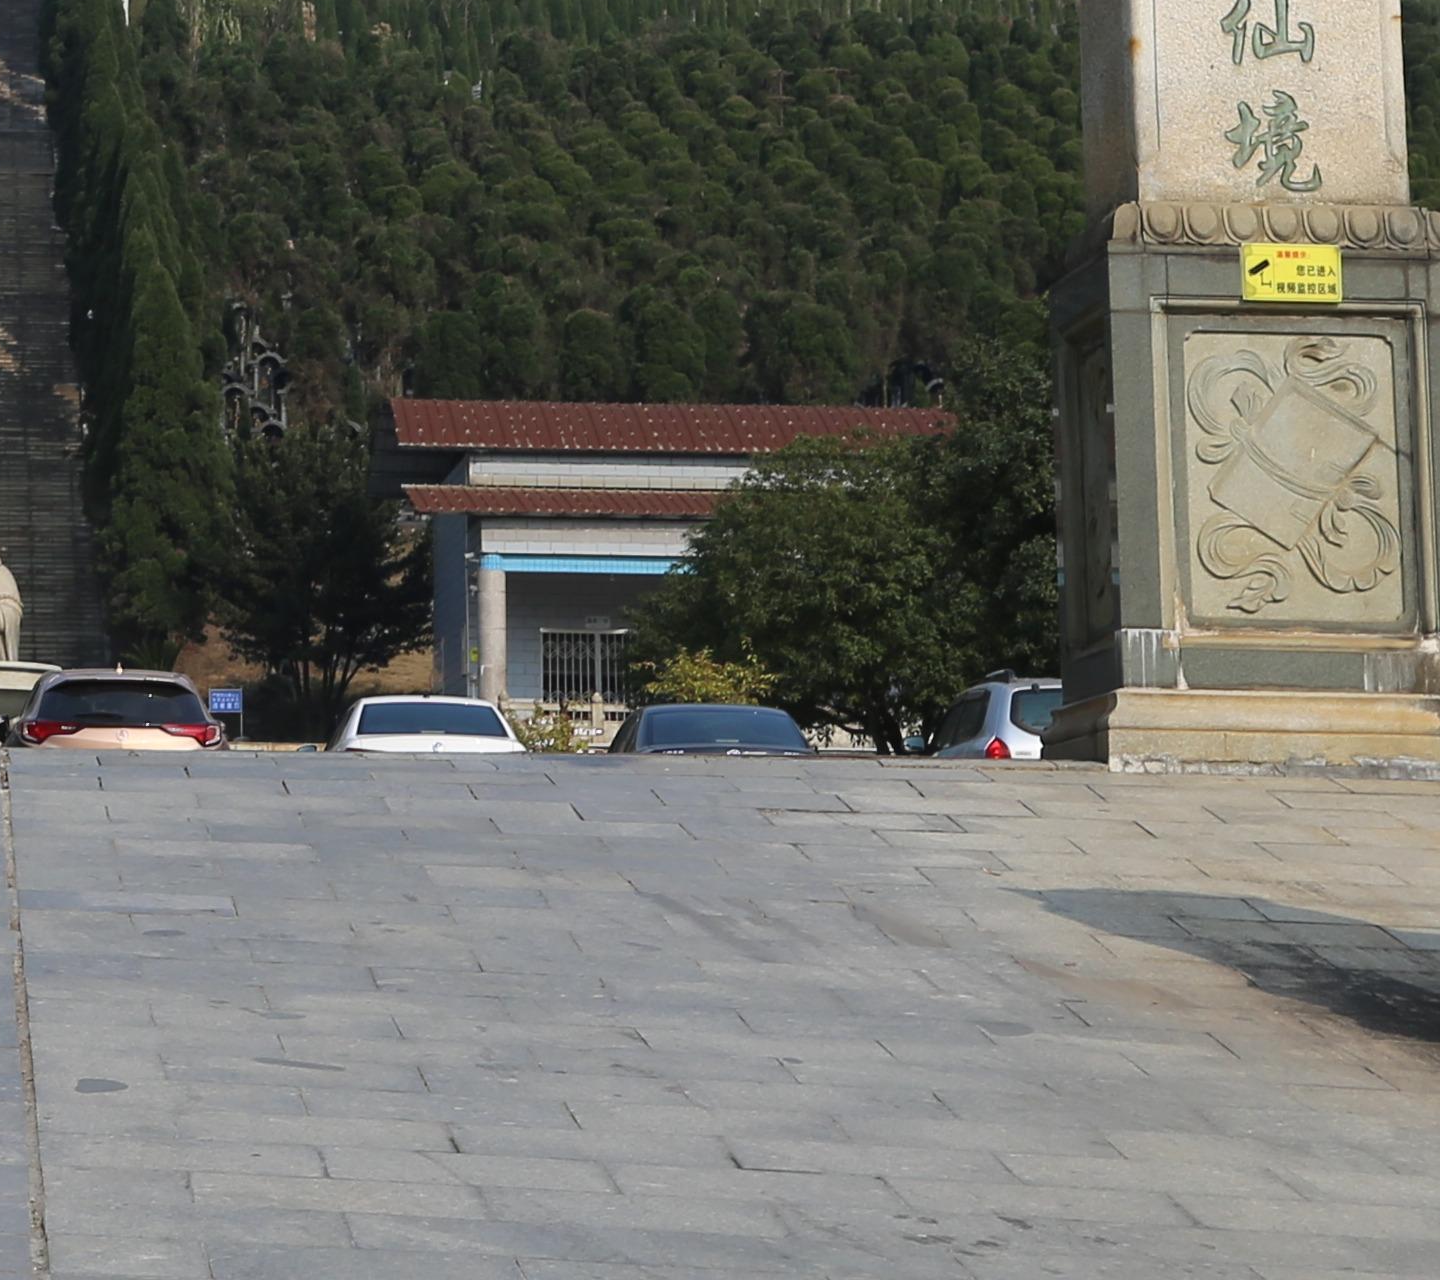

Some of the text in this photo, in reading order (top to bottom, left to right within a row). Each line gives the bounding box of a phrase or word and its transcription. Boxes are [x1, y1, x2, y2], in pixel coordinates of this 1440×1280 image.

[1295, 265, 1336, 277] 您已进入
[1276, 282, 1338, 295] 视频监控区域
